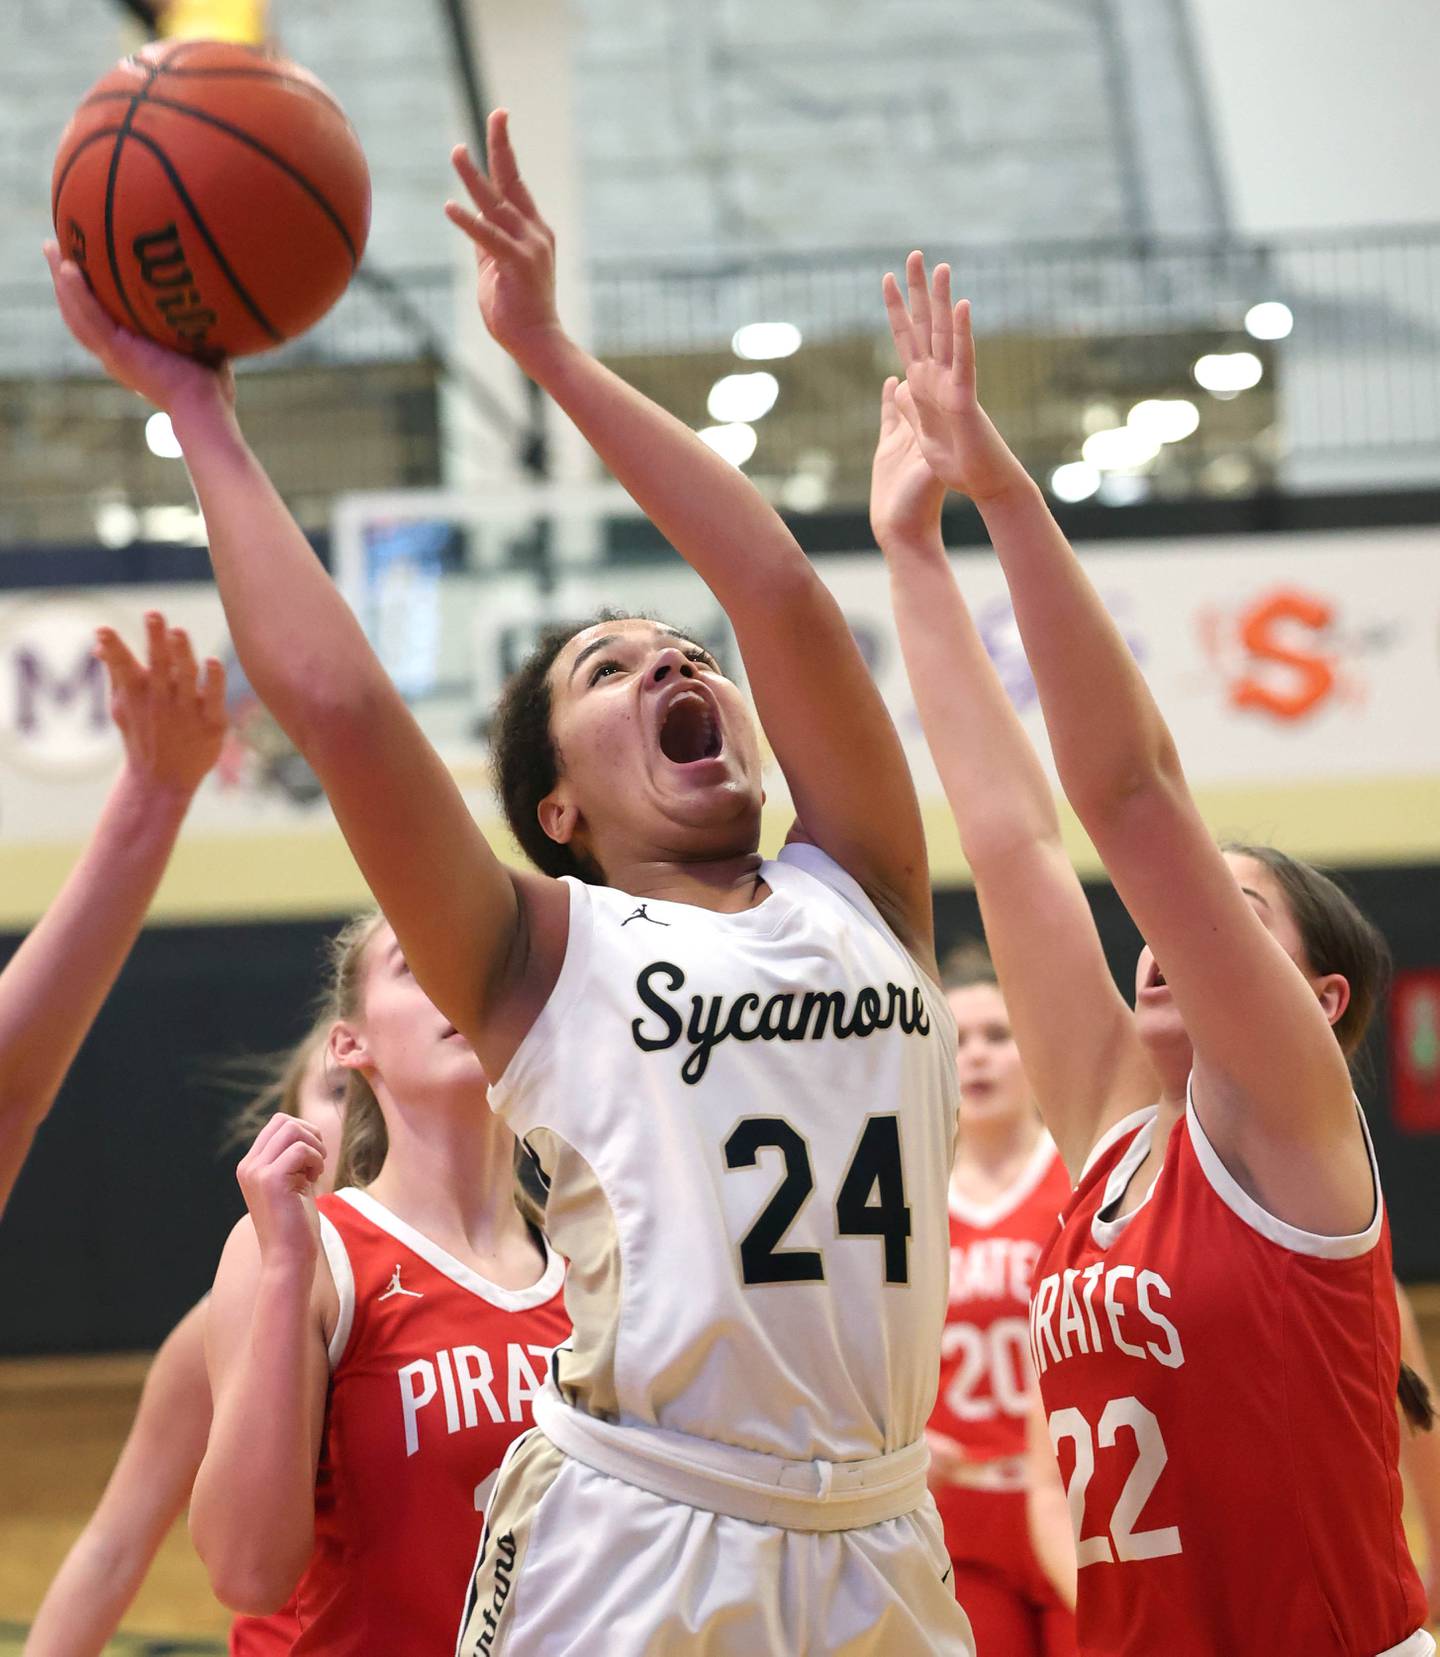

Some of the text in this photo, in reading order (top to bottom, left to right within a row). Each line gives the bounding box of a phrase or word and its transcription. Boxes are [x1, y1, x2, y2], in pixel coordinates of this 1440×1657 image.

[132, 222, 218, 345] Wil
[1229, 588, 1336, 722] S
[631, 960, 931, 1085] Sycamore
[720, 1110, 912, 1290] 24
[941, 1317, 1031, 1421] 20
[1048, 1396, 1183, 1569] 22
